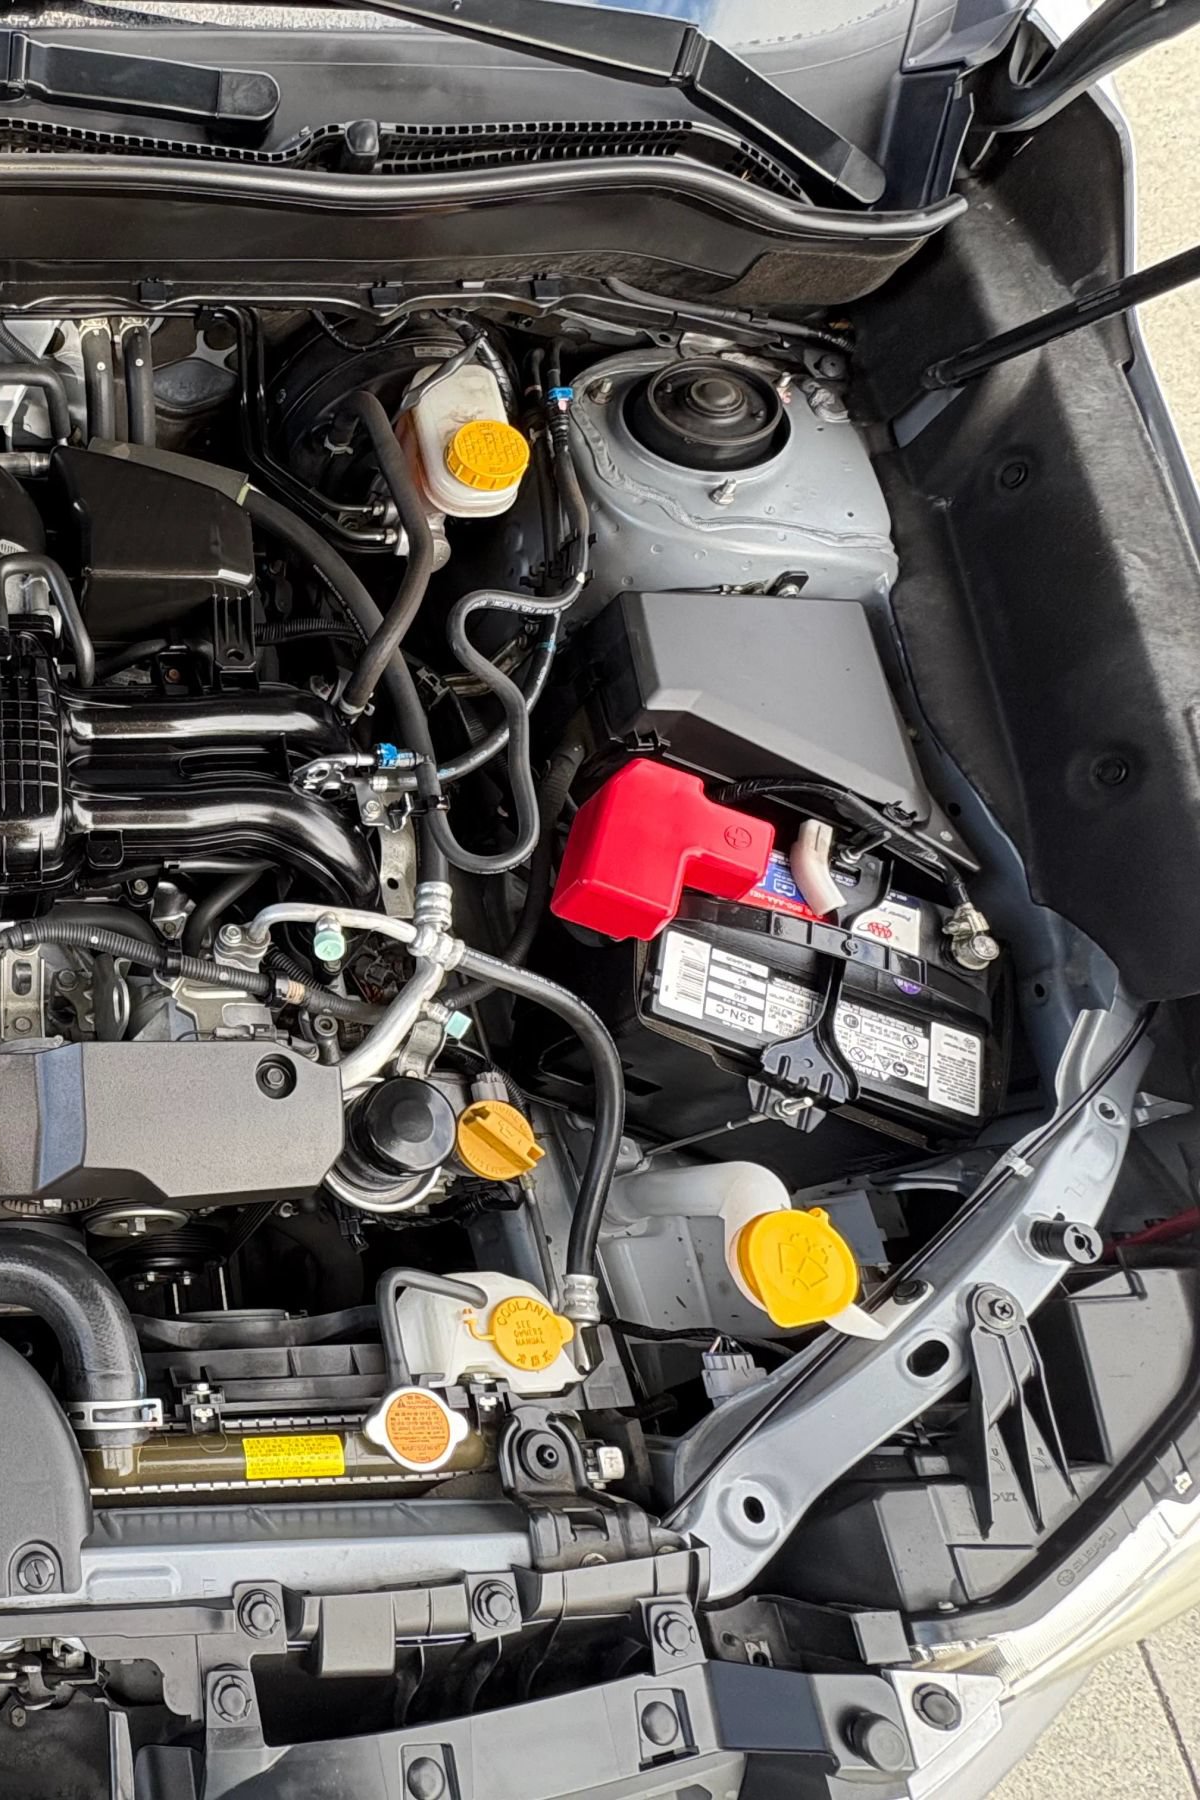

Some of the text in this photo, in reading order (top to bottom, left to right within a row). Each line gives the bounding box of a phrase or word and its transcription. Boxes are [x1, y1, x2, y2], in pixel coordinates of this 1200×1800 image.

[716, 1003, 755, 1025] 35N-C
[851, 1062, 881, 1079] DANG
[496, 1300, 552, 1327] COOLANT
[515, 1320, 531, 1330] SEE
[1072, 1526, 1117, 1574] SUBARU
